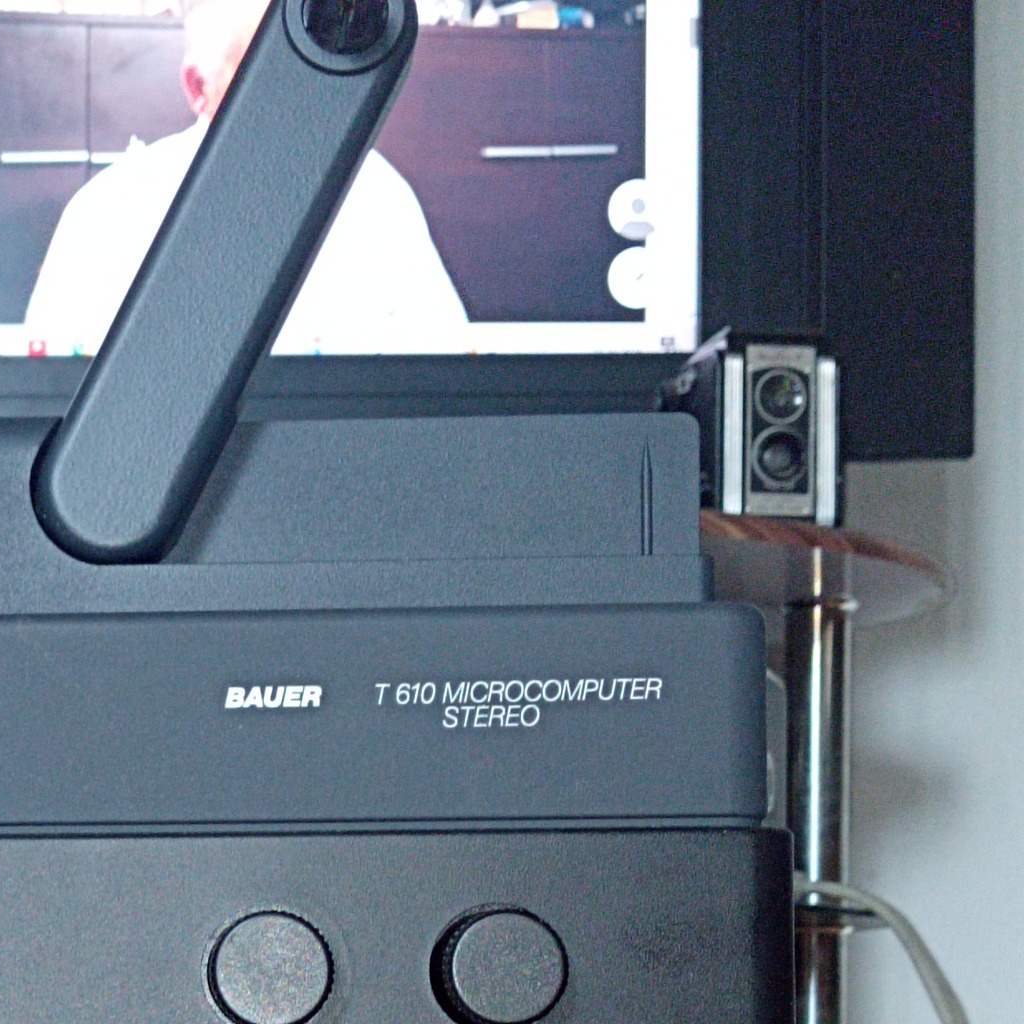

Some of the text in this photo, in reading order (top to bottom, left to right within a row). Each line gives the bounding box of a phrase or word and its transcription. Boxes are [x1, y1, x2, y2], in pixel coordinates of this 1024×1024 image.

[225, 685, 322, 708] BAUER
[375, 678, 663, 705] T 610 MICROCOMPUTER
[442, 704, 541, 729] STEREO
